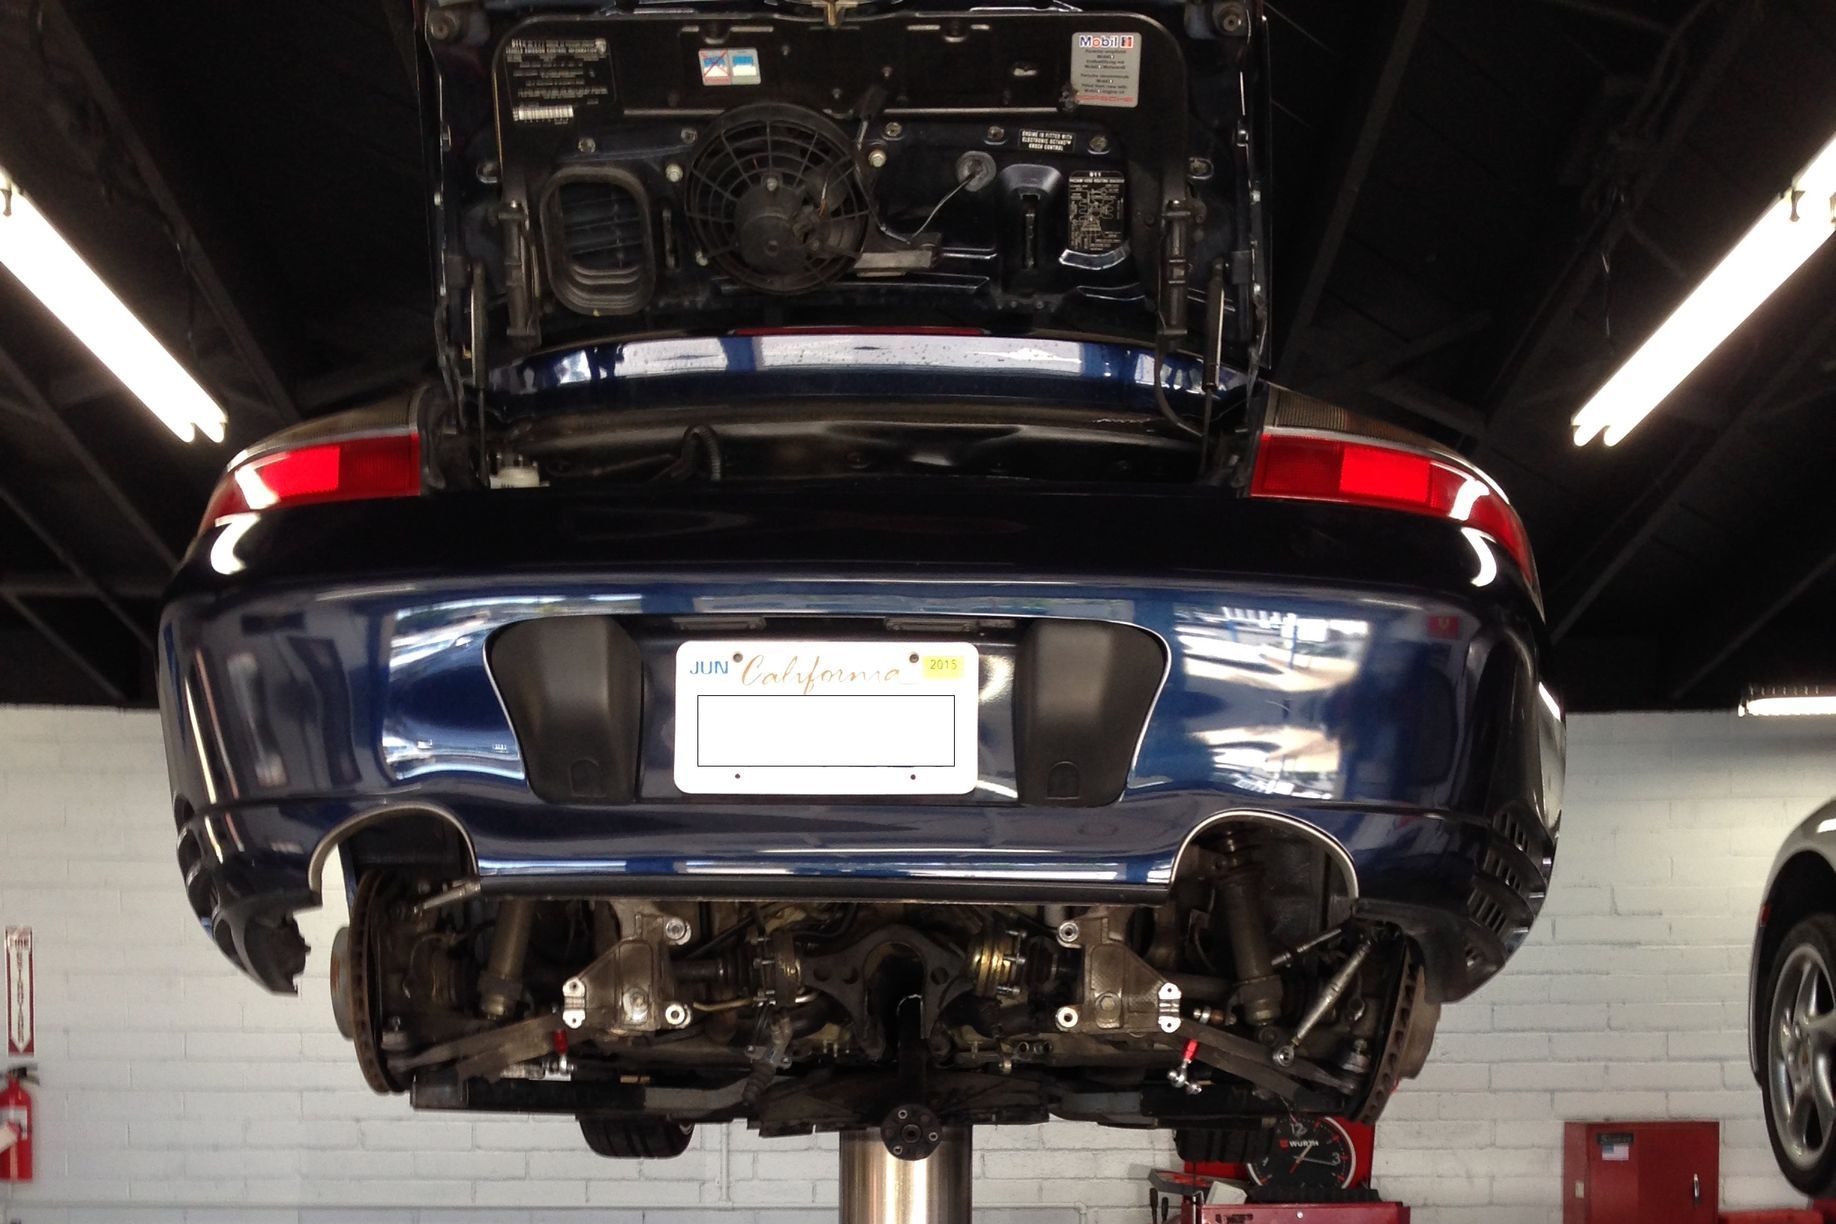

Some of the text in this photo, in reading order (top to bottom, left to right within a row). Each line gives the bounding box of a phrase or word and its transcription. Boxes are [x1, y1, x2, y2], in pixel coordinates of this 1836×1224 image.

[1080, 35, 1118, 47] Mobil
[930, 658, 957, 670] 2015
[689, 654, 903, 694] JUN California
[1290, 1122, 1308, 1137] 12
